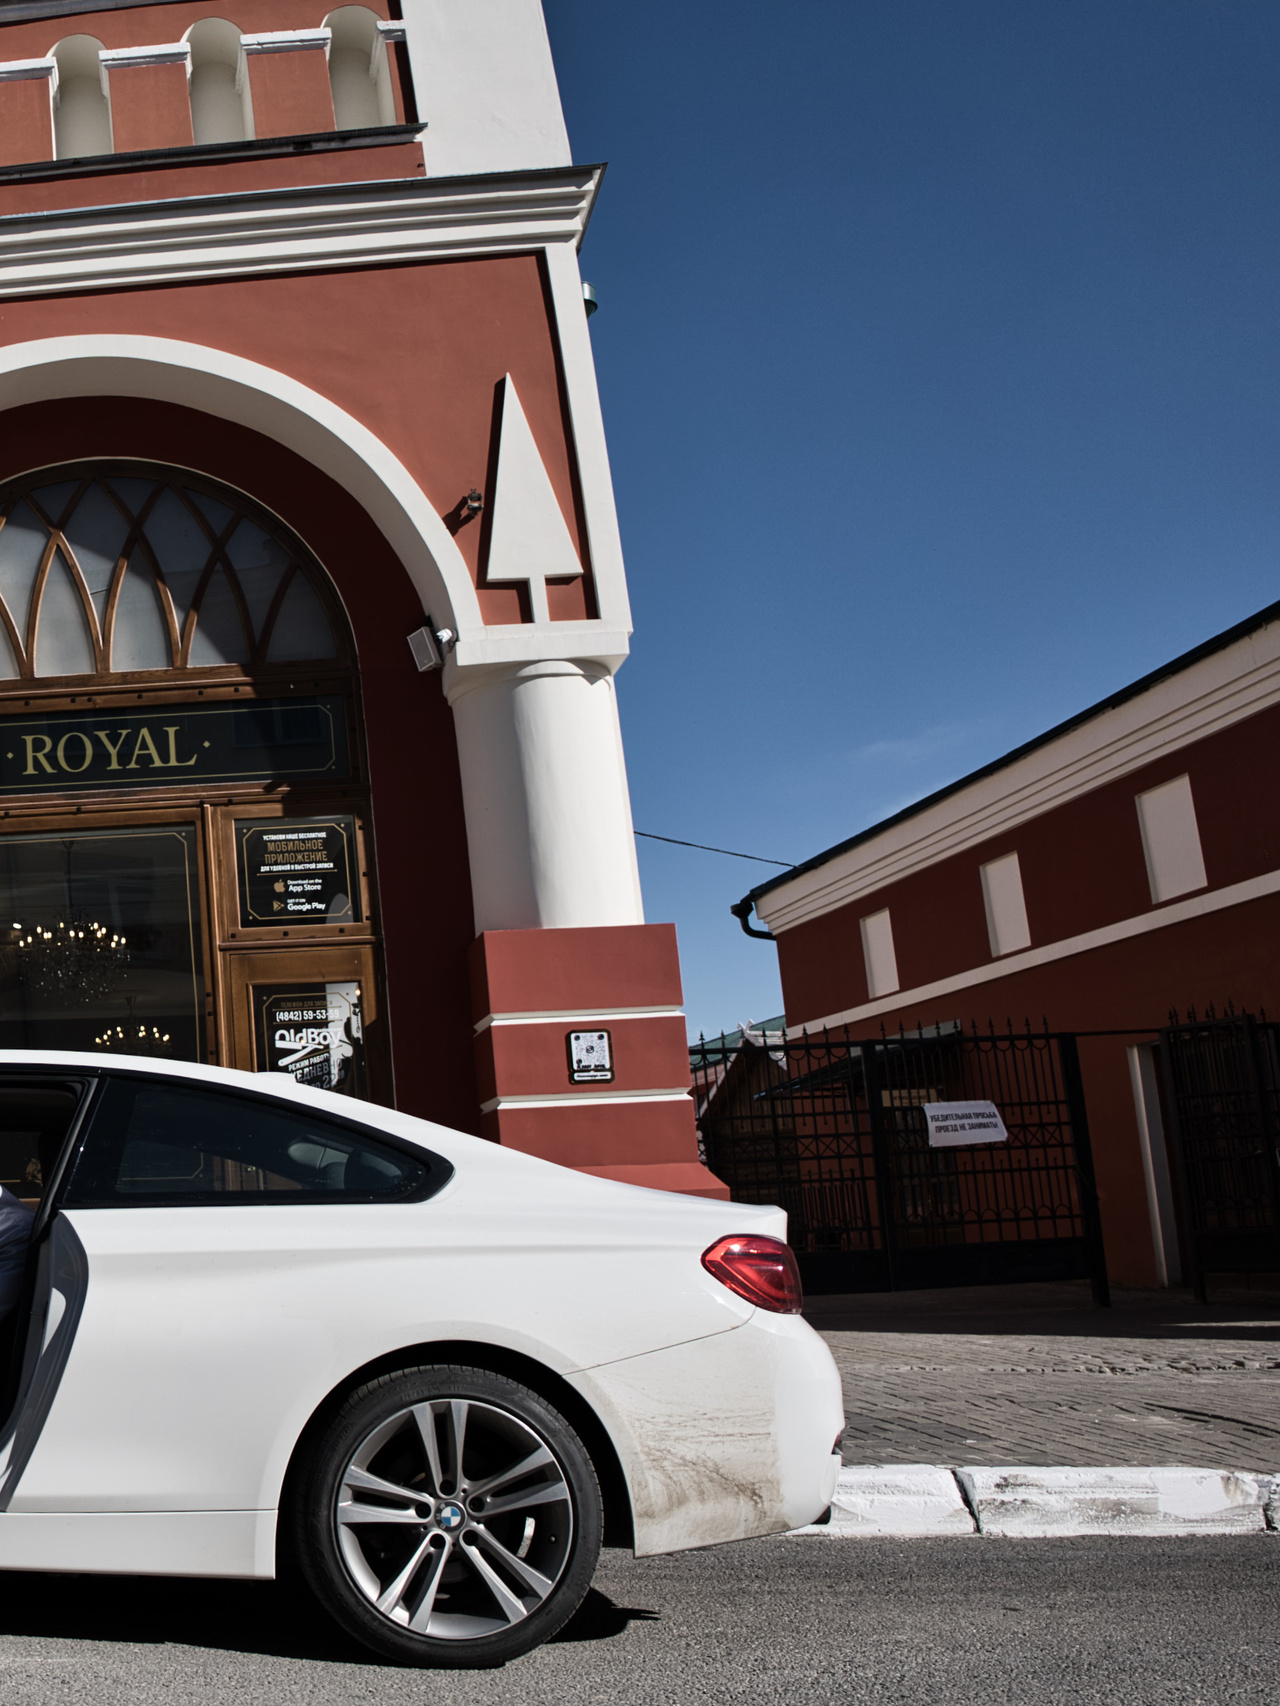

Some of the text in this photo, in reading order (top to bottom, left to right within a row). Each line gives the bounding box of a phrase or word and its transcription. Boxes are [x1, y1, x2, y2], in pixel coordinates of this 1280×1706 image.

[21, 726, 198, 775] ROYAL
[267, 840, 324, 852] МОБИЛЬНОЕ
[264, 852, 328, 864] ПРИЛОЖЕНИЕ
[287, 902, 326, 911] Google Play
[276, 1009, 339, 1022] (4842) 59-53-59
[275, 1028, 342, 1048] OldBoy
[288, 1059, 309, 1071] РЕЖИМ
[930, 1112, 973, 1122] УБЕДИТЕЛЬНАЯ
[935, 1124, 959, 1133] ПРОЕЗД
[960, 1123, 967, 1131] НЕ
